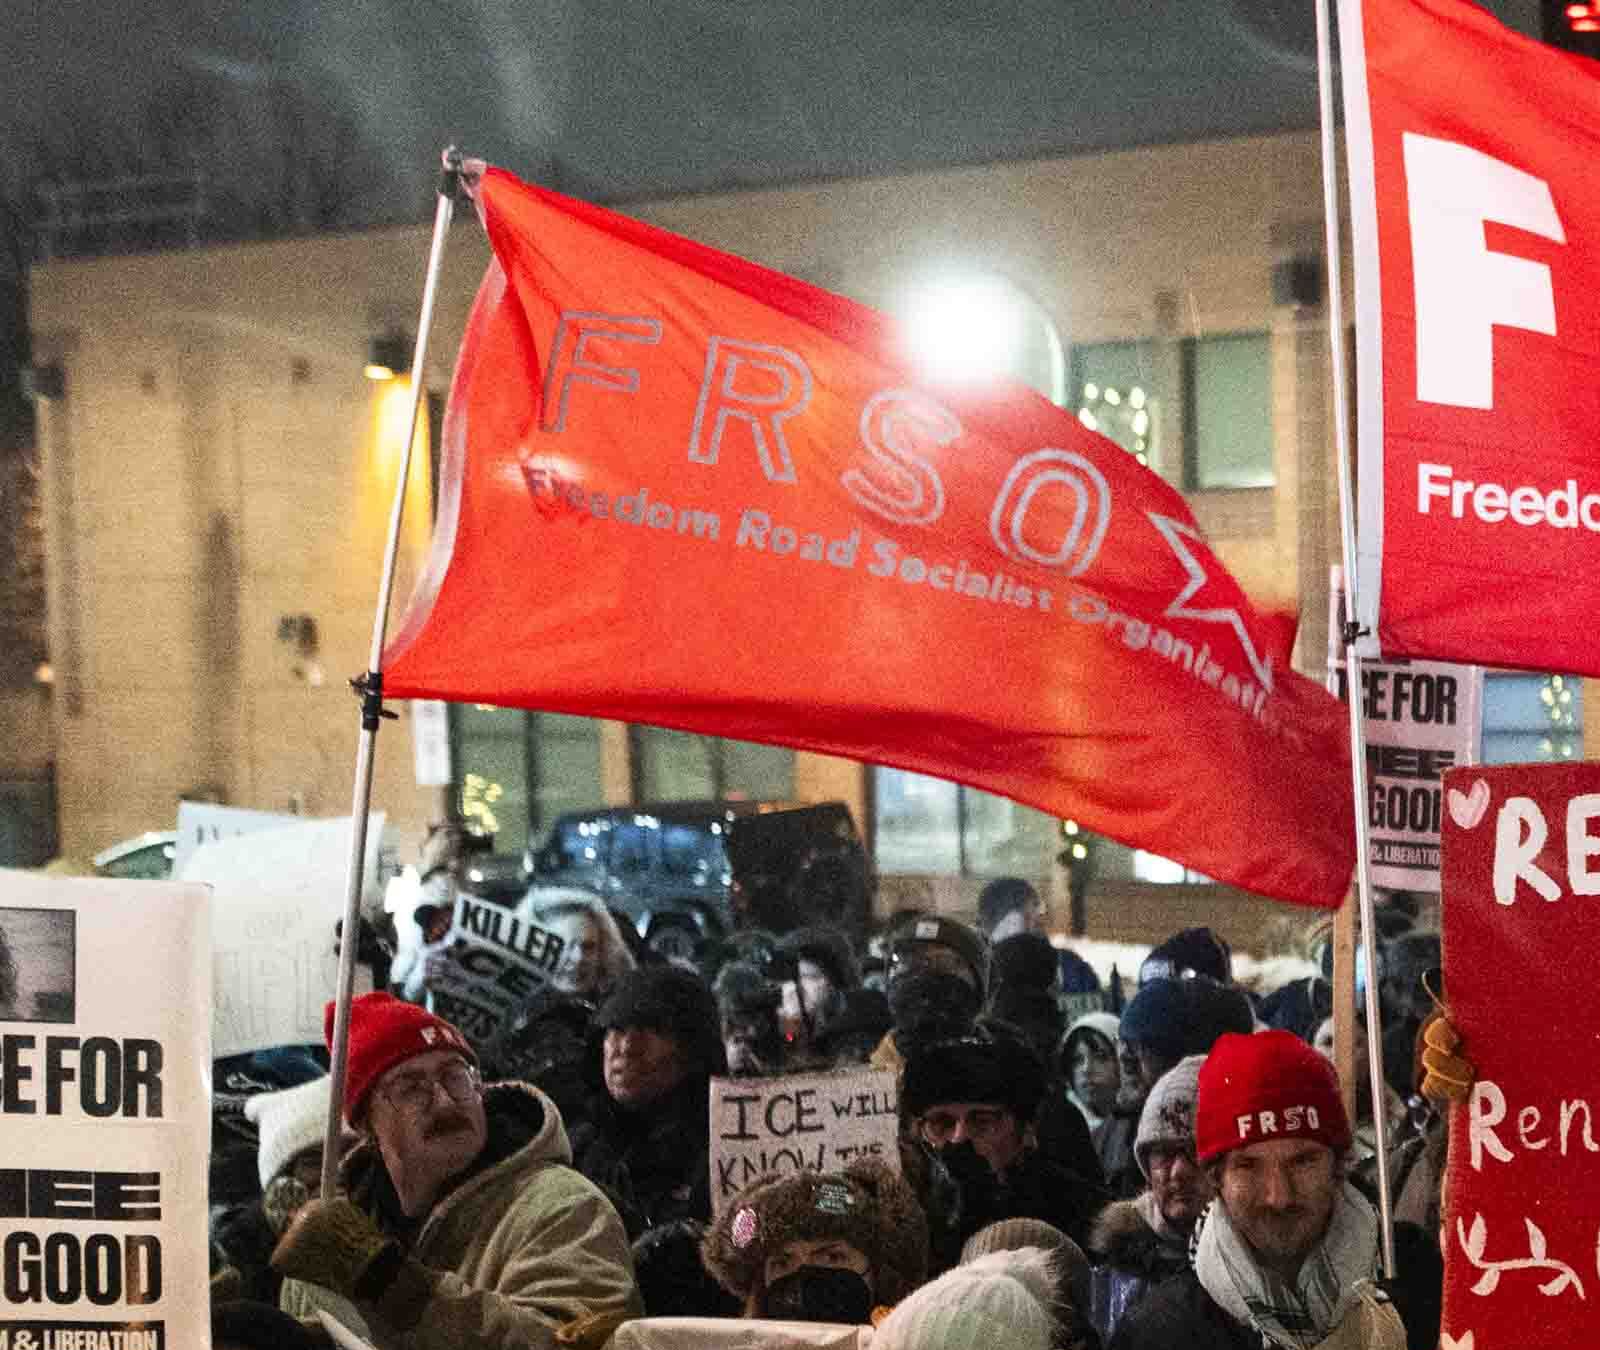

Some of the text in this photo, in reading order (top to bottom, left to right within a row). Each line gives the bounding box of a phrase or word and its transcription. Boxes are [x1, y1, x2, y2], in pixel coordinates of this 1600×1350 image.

[540, 311, 1112, 577] FRSO
[736, 506, 862, 568] Road
[868, 536, 1055, 612] Socialist
[1393, 673, 1457, 725] FOR
[1369, 783, 1440, 834] GOO
[1384, 847, 1440, 867] LIBERATIO
[460, 899, 565, 971] KILLER
[46, 1034, 163, 1119] FOR
[719, 1088, 898, 1141] ICE WILL
[1237, 1104, 1321, 1139] FRSO
[3, 1230, 163, 1307] GOOD
